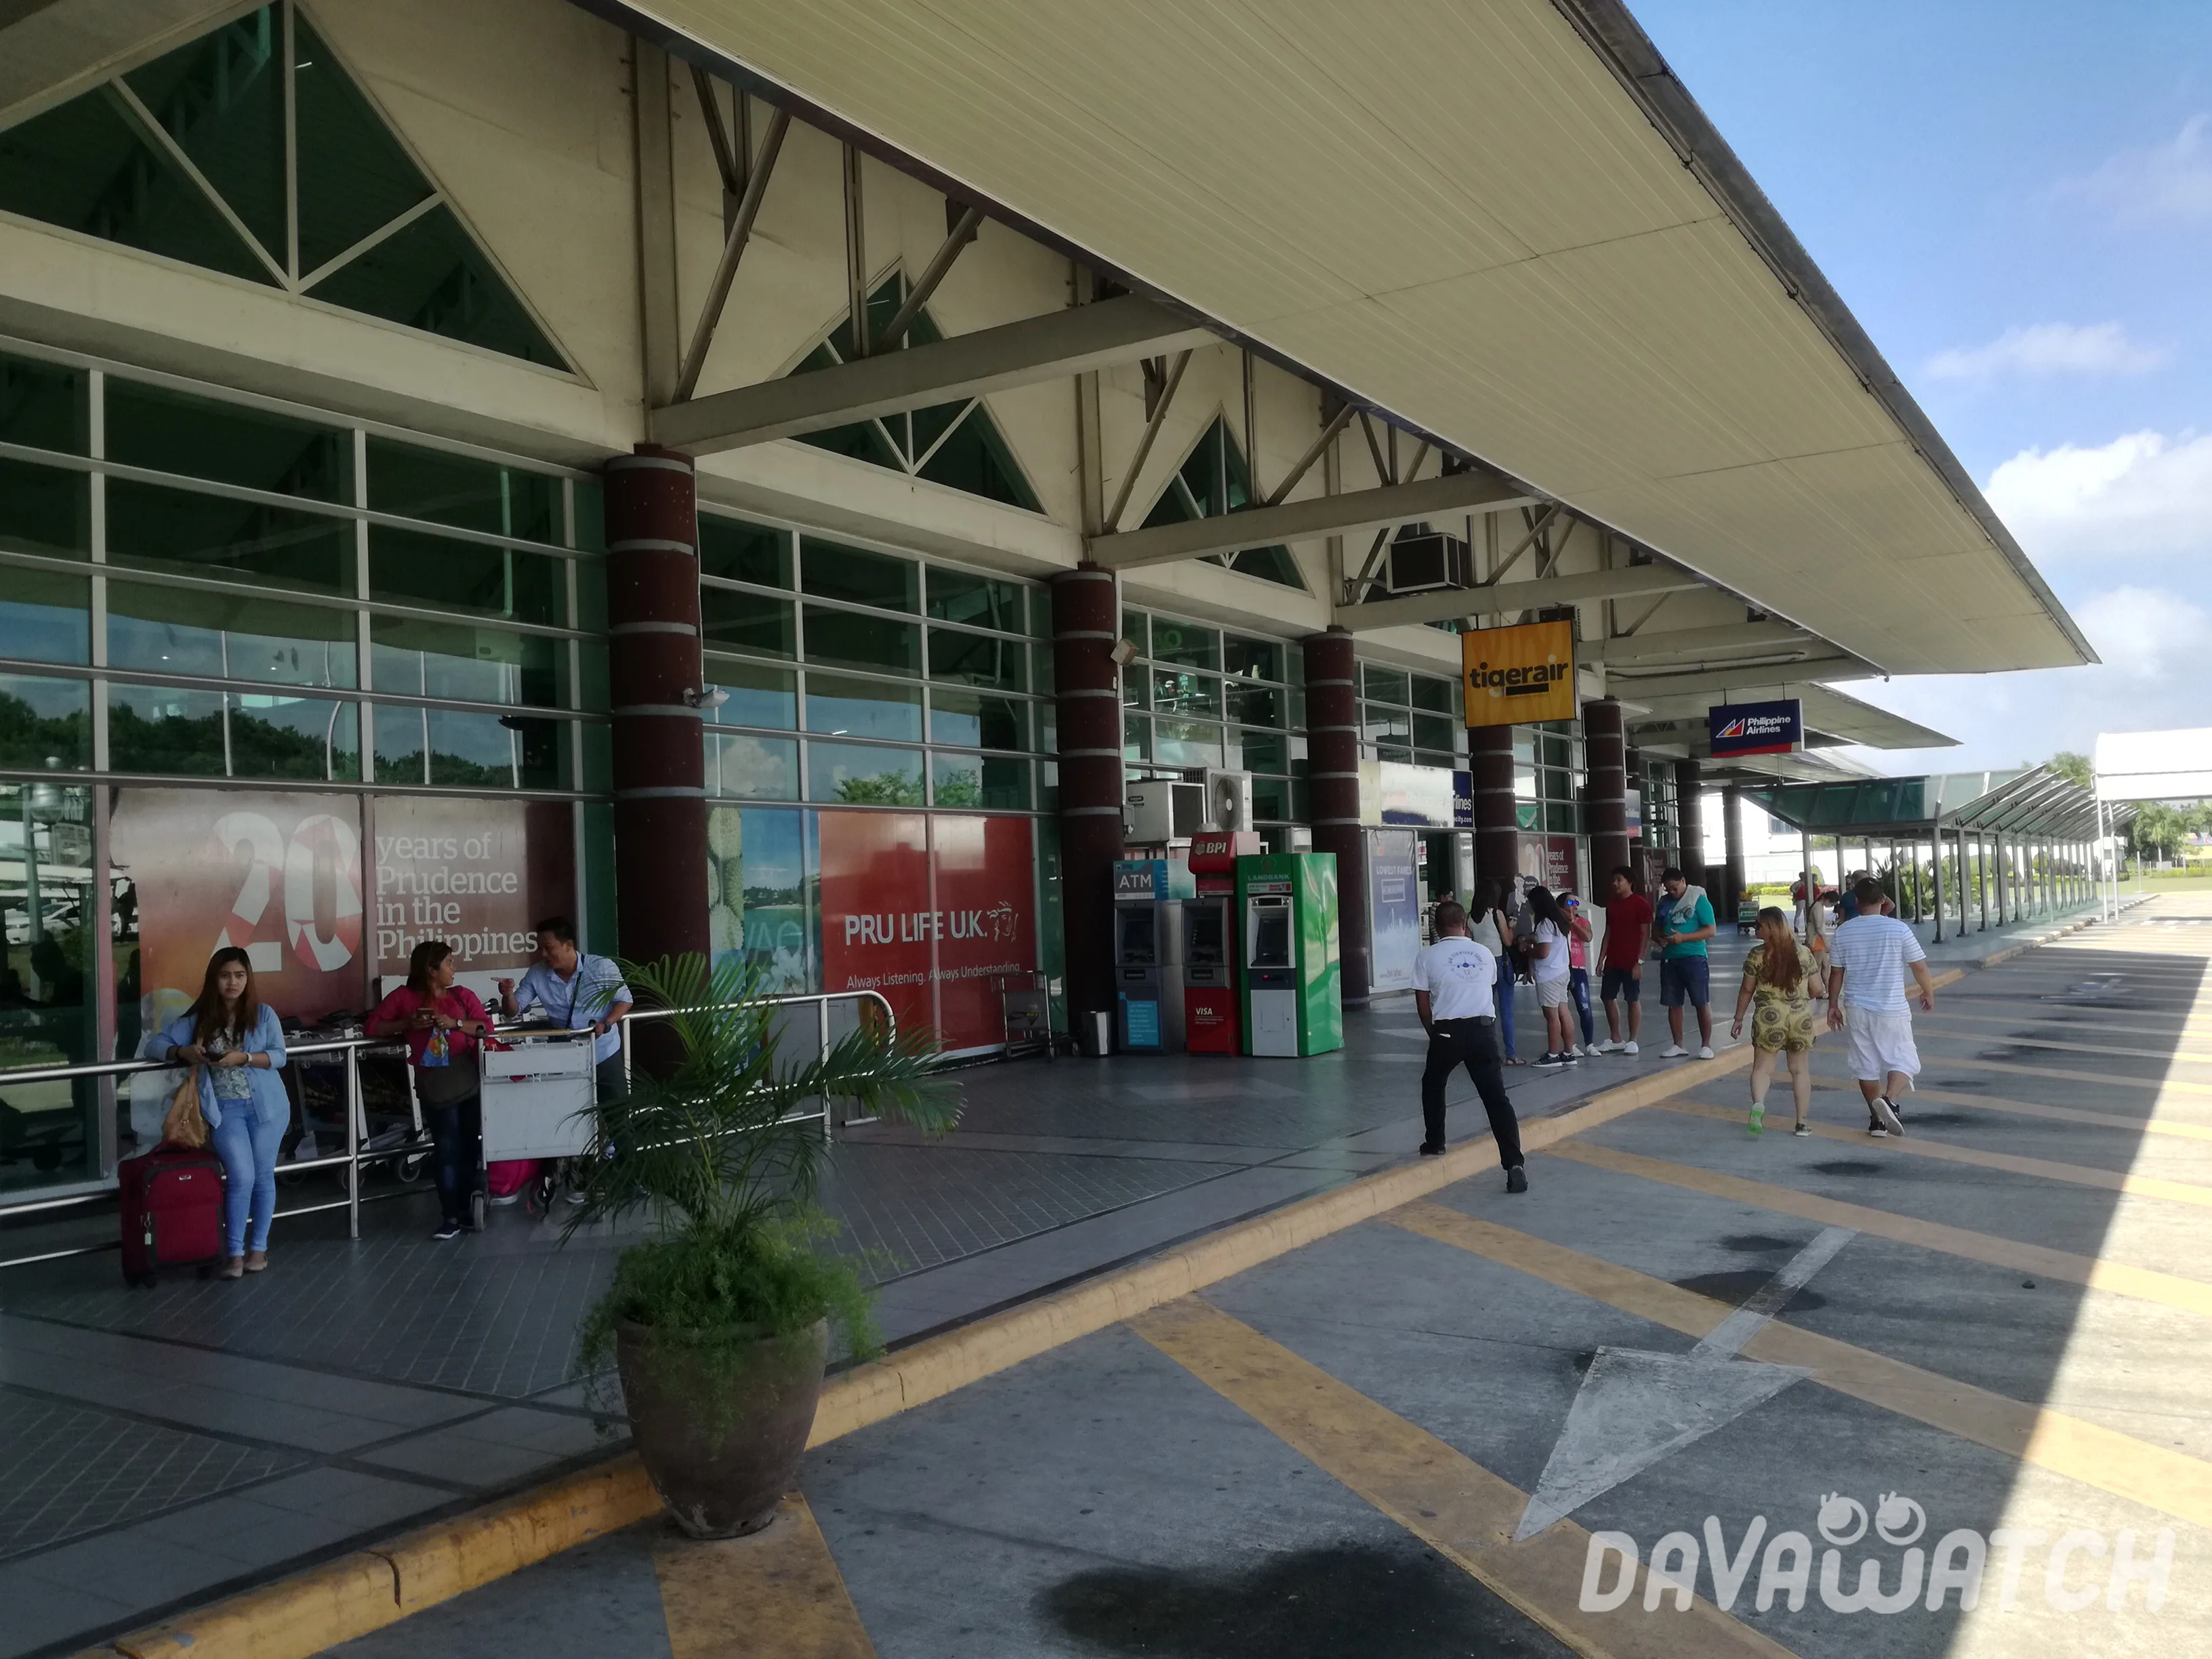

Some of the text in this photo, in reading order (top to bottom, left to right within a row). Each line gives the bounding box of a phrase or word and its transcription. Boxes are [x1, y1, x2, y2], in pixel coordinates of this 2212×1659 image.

[1469, 653, 1569, 698] tigerair
[1746, 726, 1781, 735] Airlines
[1747, 716, 1791, 726] Philippine
[375, 832, 492, 865] years of
[1206, 842, 1227, 854] BPI
[375, 866, 518, 895] Prudence
[1119, 874, 1152, 888] ATM
[1376, 865, 1413, 875] LOWEST FARES
[209, 811, 364, 972] 20
[376, 896, 461, 926] in the
[845, 909, 988, 945] PRU LIFE U.K.
[846, 961, 1020, 989] Always Listening. Always Understanding
[1195, 1007, 1213, 1016] VISA
